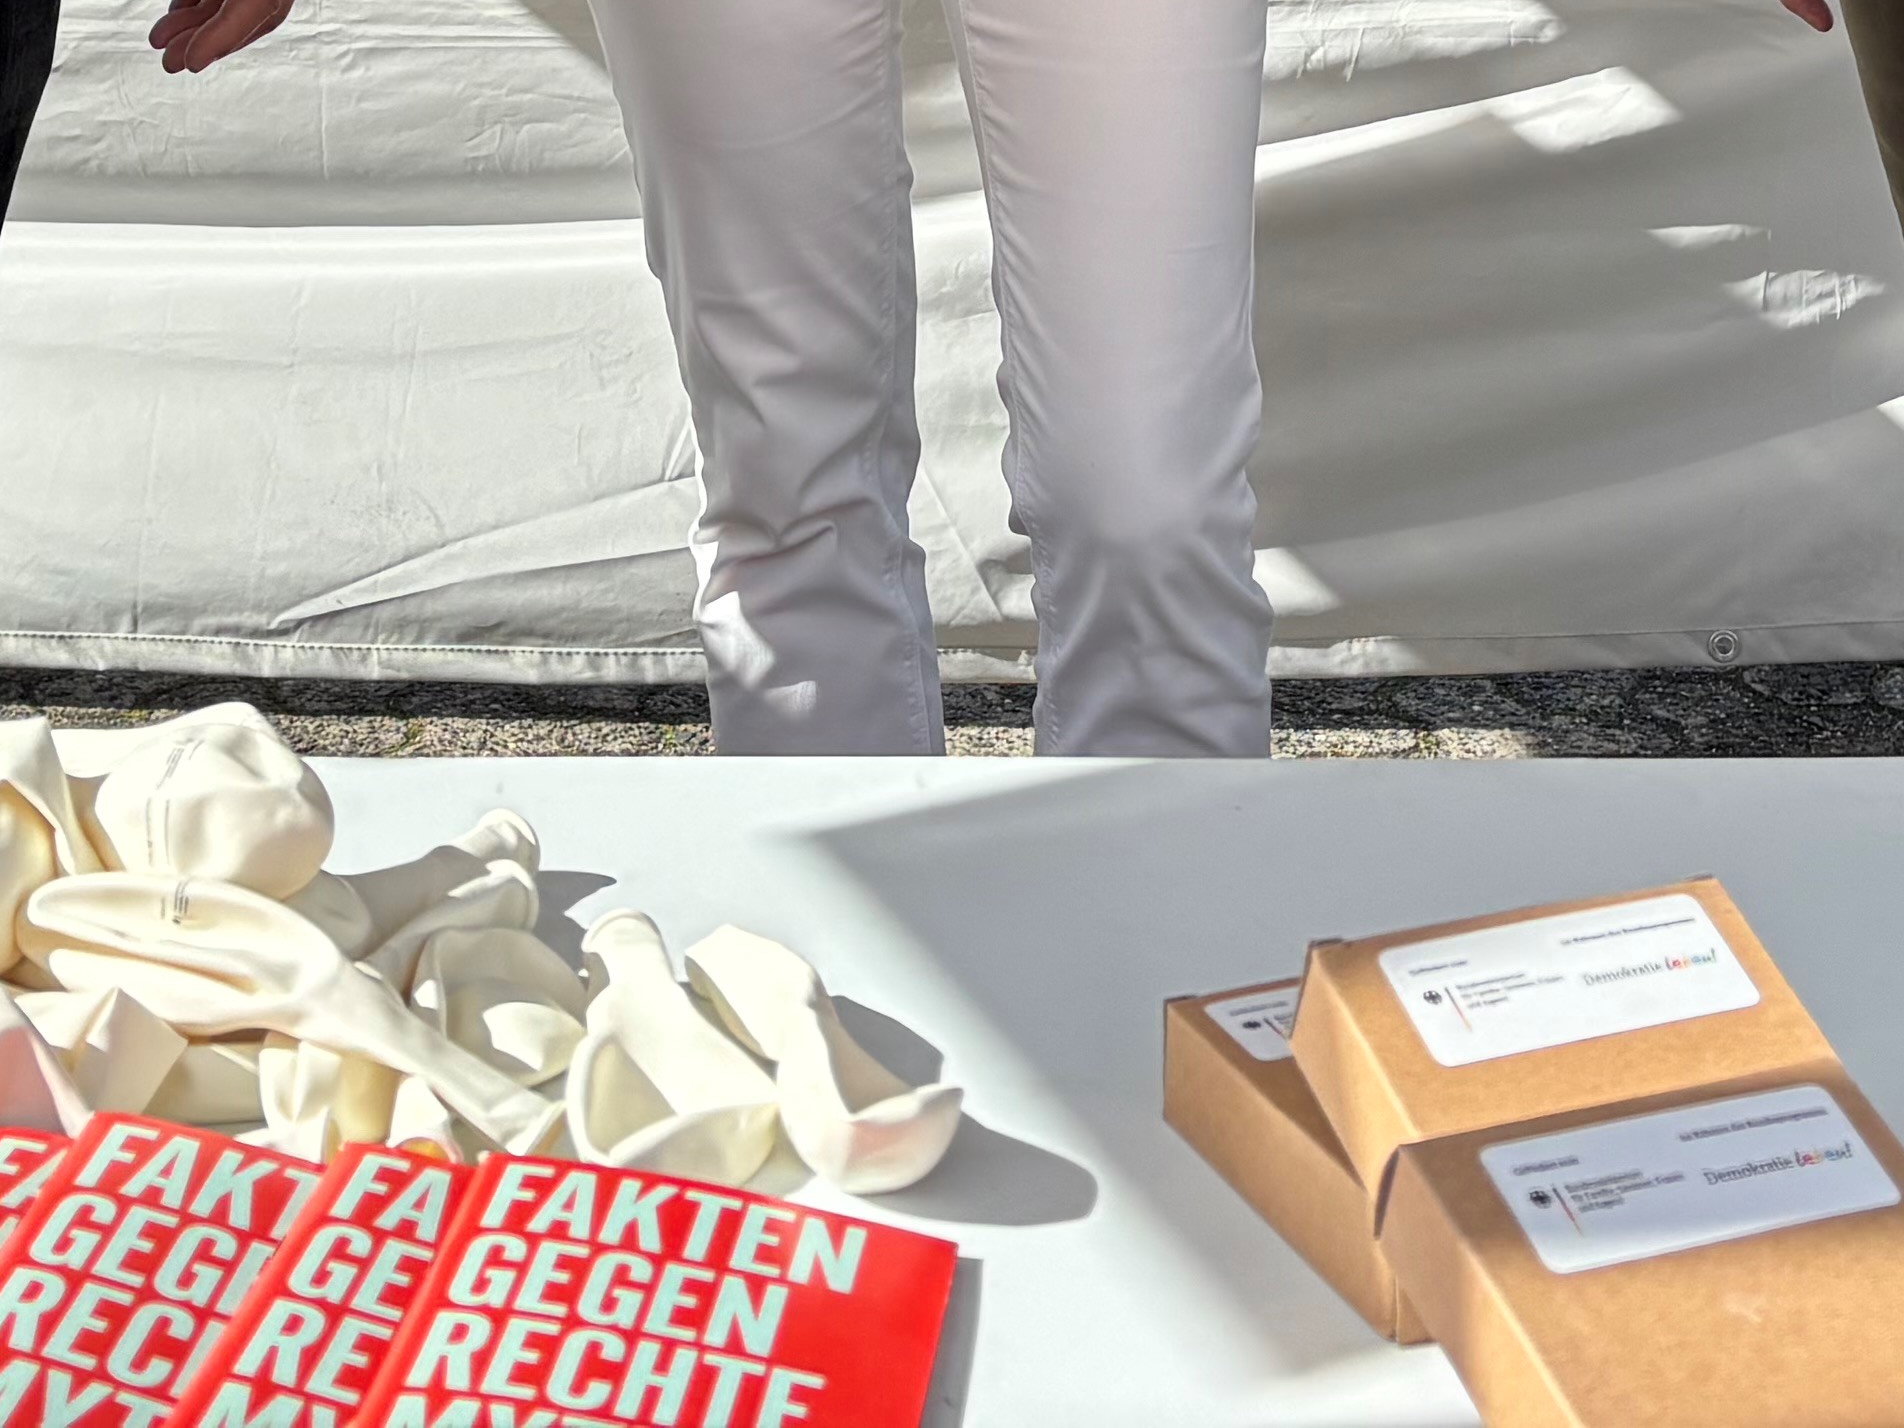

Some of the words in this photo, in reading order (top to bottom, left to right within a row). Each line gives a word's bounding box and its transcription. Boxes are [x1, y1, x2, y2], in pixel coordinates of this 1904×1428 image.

[480, 1163, 868, 1295] FAKTEN
[1702, 1156, 1795, 1186] Demokratie
[447, 1233, 789, 1358] GEGEN
[405, 1310, 828, 1428] RECHTE
